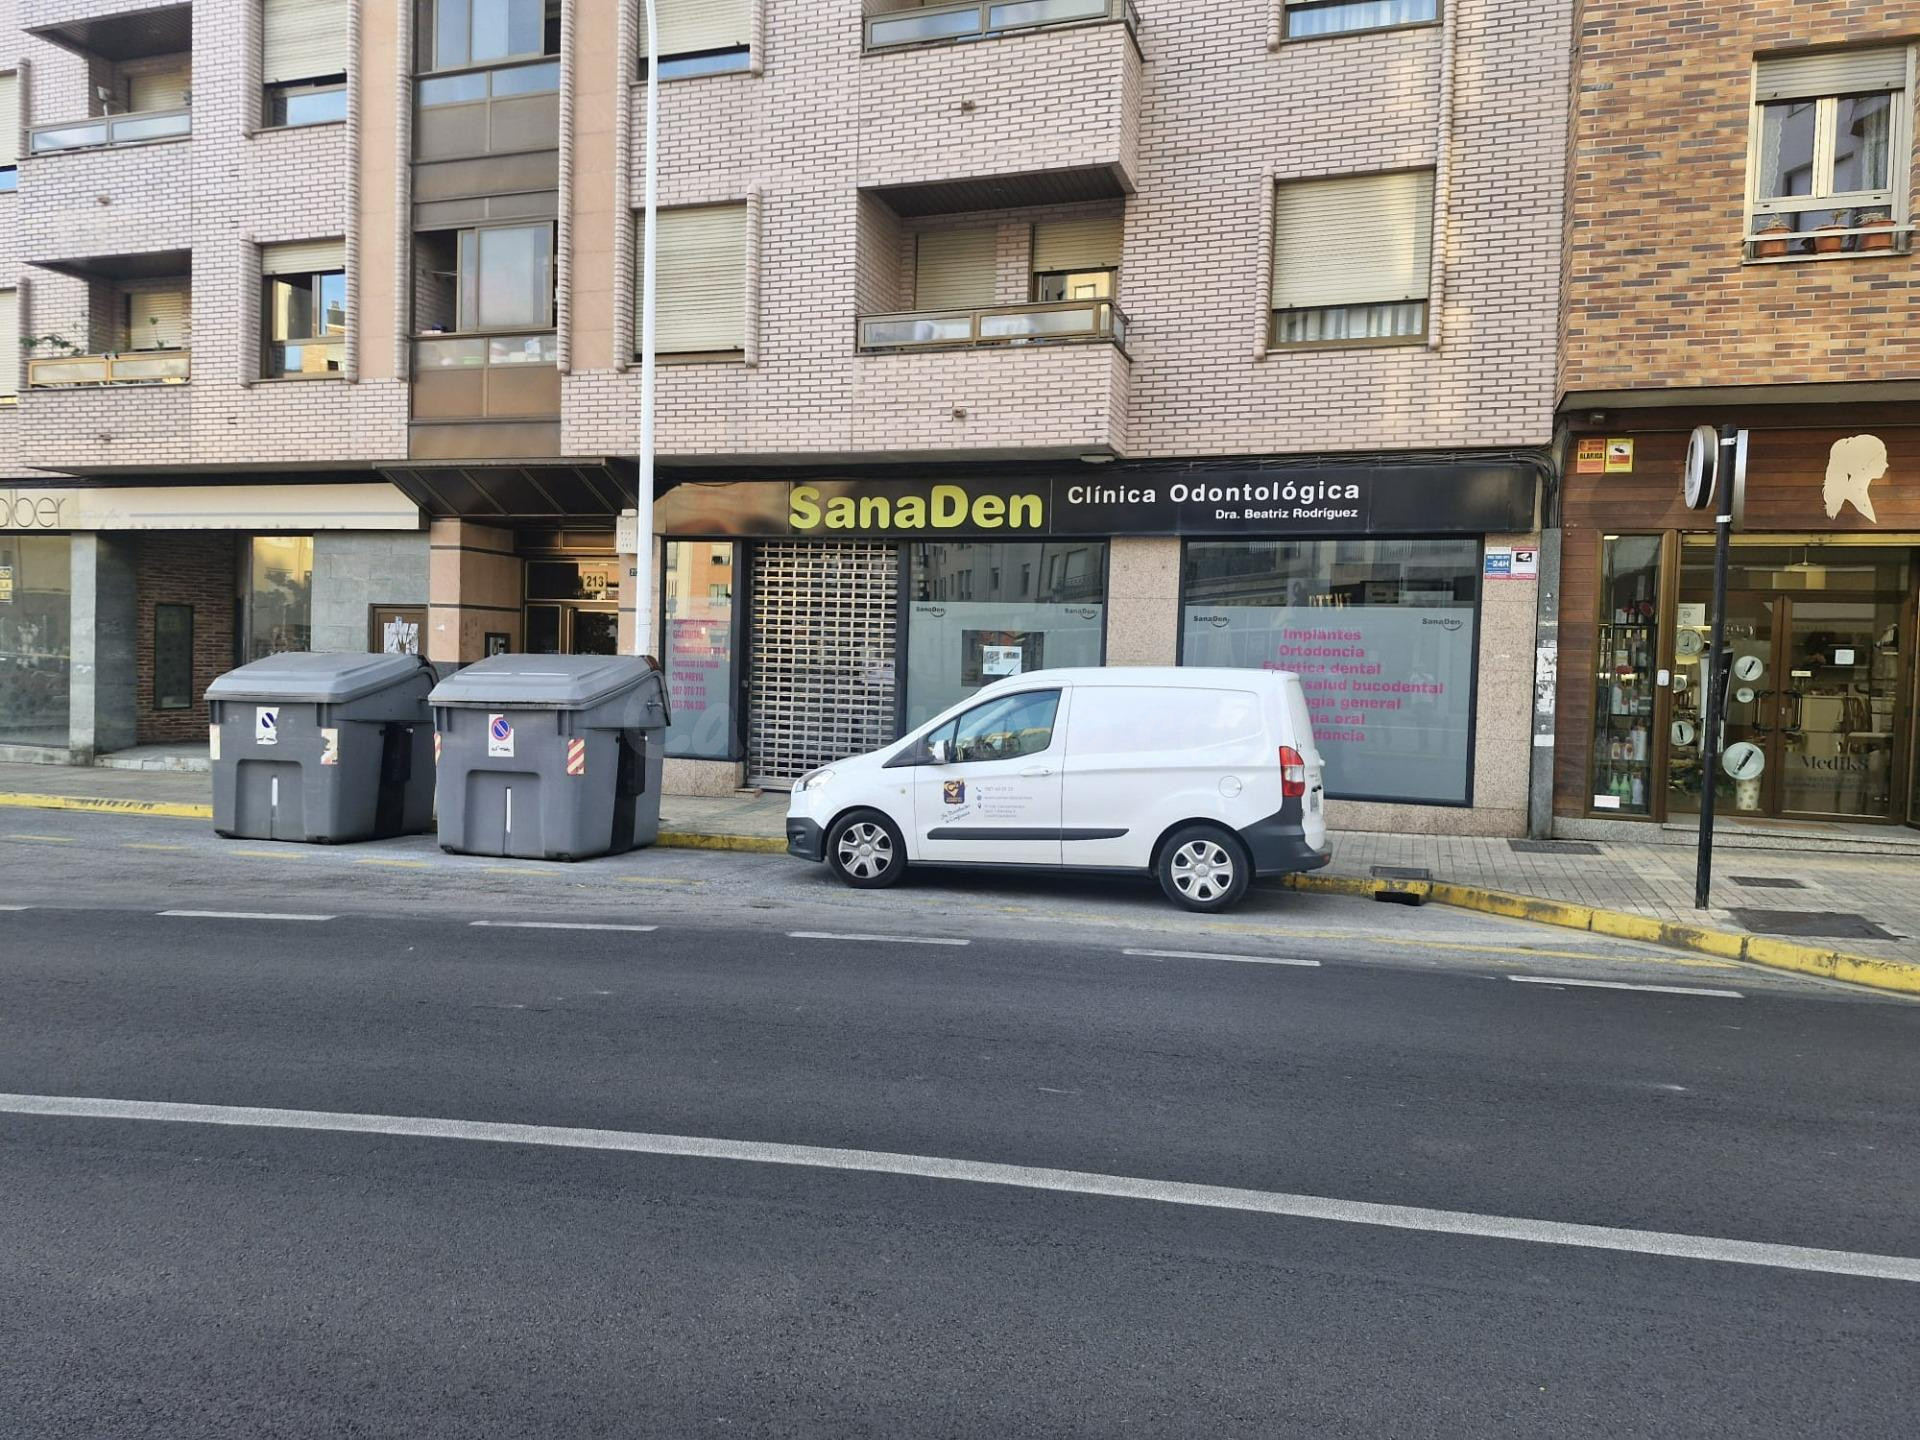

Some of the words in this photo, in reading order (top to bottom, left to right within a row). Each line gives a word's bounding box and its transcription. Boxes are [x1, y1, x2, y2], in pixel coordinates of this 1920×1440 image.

[1067, 486, 1156, 504] Clínica
[1169, 480, 1360, 504] Odontológica
[789, 485, 1043, 529] SanaDen
[1215, 509, 1240, 519] Dra.
[1244, 508, 1289, 519] Beatriz
[1293, 507, 1358, 520] Rodríguez
[586, 575, 604, 587] 213
[1422, 617, 1460, 625] SanaDen
[1283, 628, 1362, 642] Implantes
[1279, 645, 1366, 658] Ortodoncia
[1330, 662, 1382, 675] dental
[1305, 680, 1347, 692] salud
[1352, 680, 1444, 694] bucodental
[1340, 698, 1401, 711] general
[1334, 714, 1366, 725] oral
